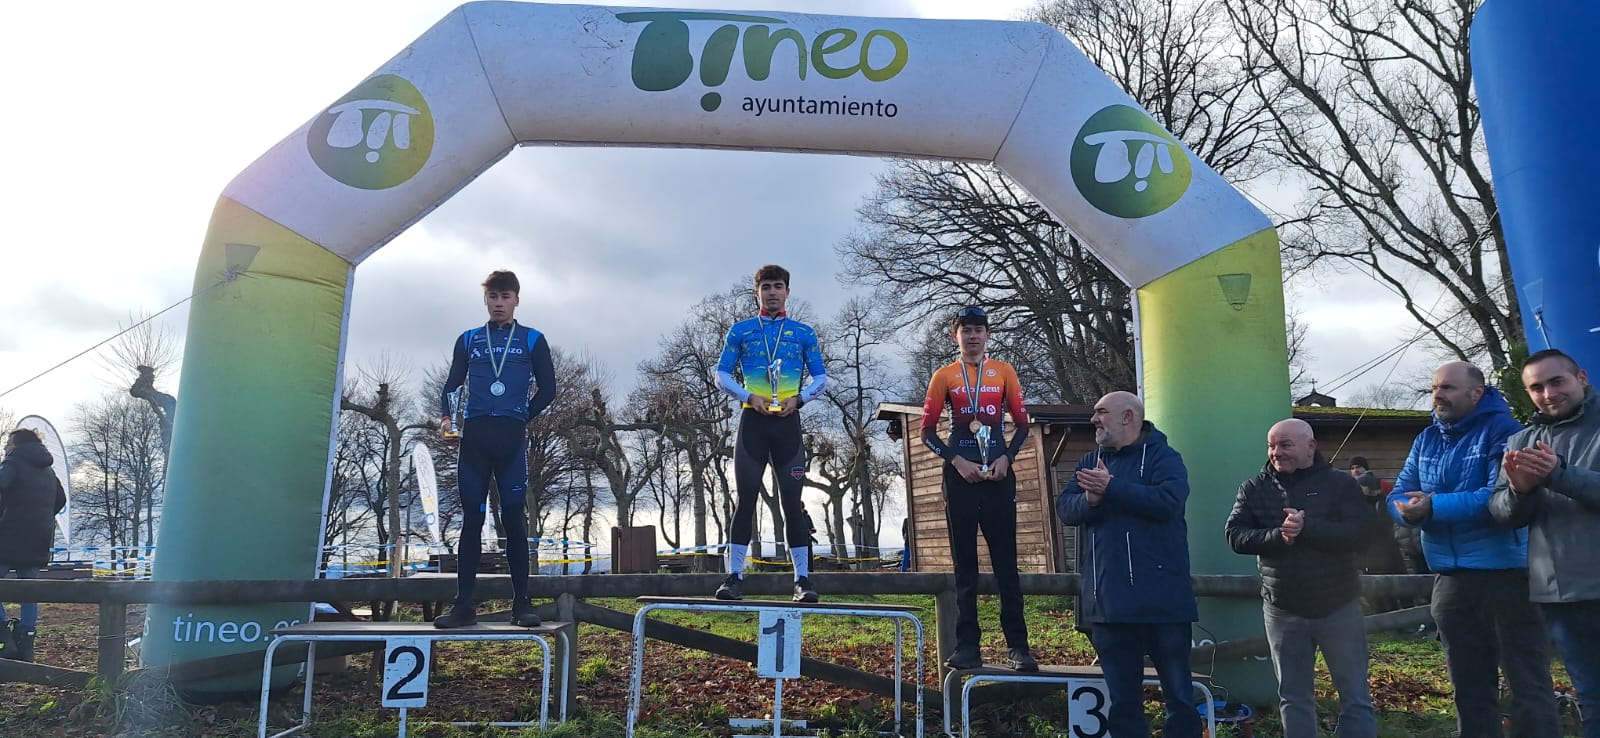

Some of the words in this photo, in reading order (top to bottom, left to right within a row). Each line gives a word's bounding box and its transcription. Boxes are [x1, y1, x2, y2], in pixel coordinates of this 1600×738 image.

[615, 12, 909, 112] Tineo
[742, 95, 898, 117] ayuntamiento
[961, 385, 1000, 393] Ocdent
[762, 618, 785, 673] 1
[387, 645, 426, 700] 2
[1071, 686, 1108, 738] 3
